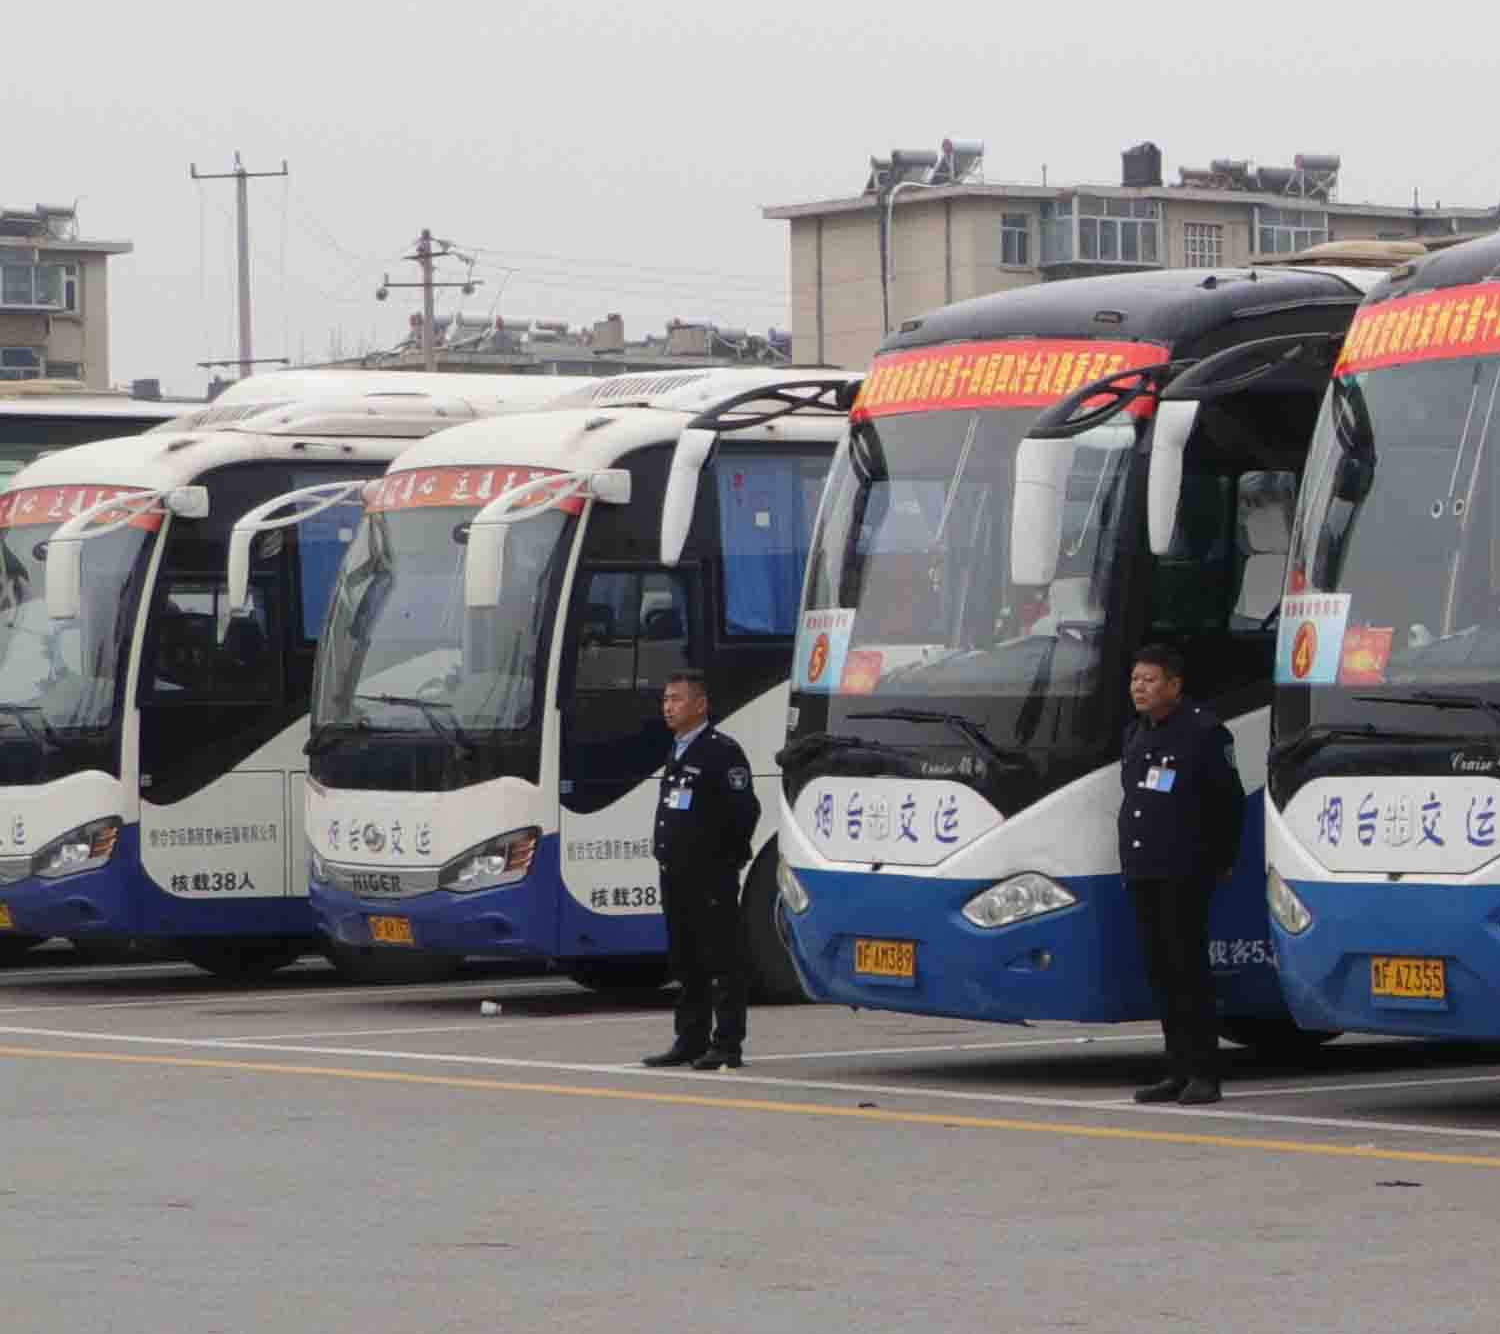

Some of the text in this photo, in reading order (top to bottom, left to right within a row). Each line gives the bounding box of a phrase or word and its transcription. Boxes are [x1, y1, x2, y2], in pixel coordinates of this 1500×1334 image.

[814, 790, 961, 845] 烟台交运
[1316, 792, 1497, 847] 烟台交运
[171, 871, 256, 893] 核载38人
[590, 885, 663, 908] 核载38
